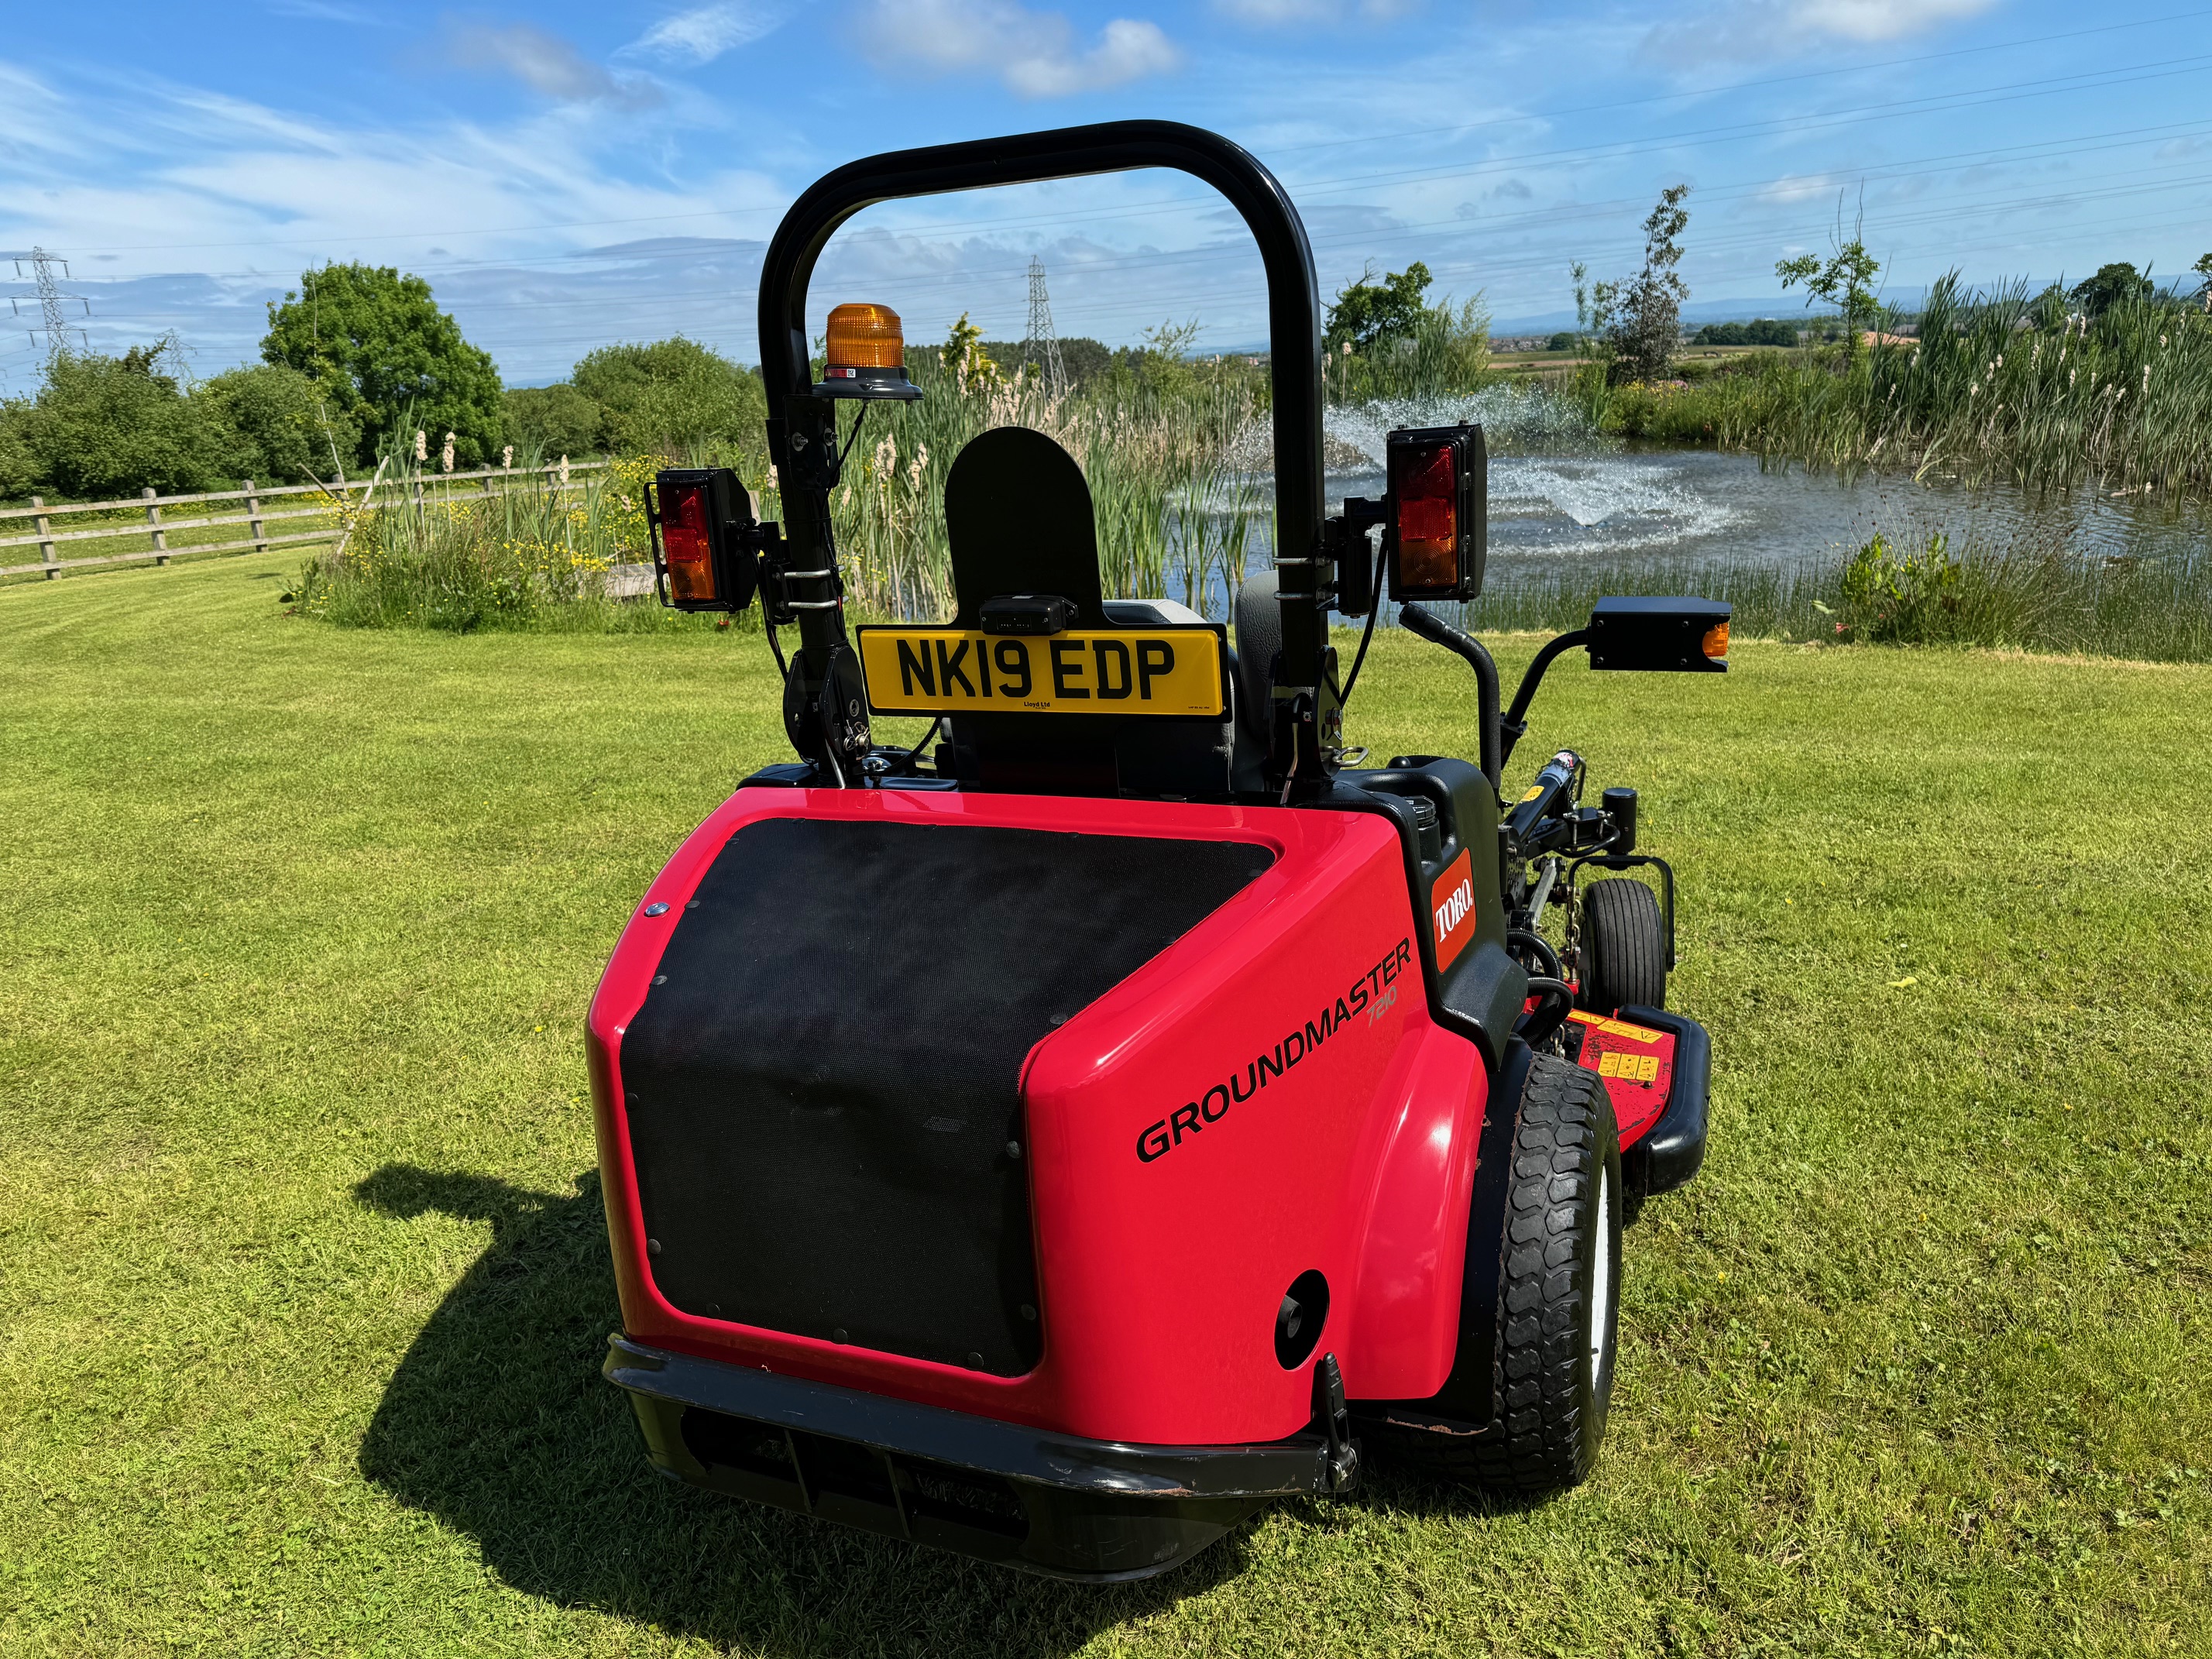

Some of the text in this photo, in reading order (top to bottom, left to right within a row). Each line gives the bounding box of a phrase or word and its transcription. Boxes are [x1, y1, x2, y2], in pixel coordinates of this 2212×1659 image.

[896, 639, 1175, 699] NK19 EDP
[1435, 878, 1472, 943] TORO
[1366, 985, 1397, 1028] 7210
[1135, 936, 1412, 1163] GROUNDMASTER
